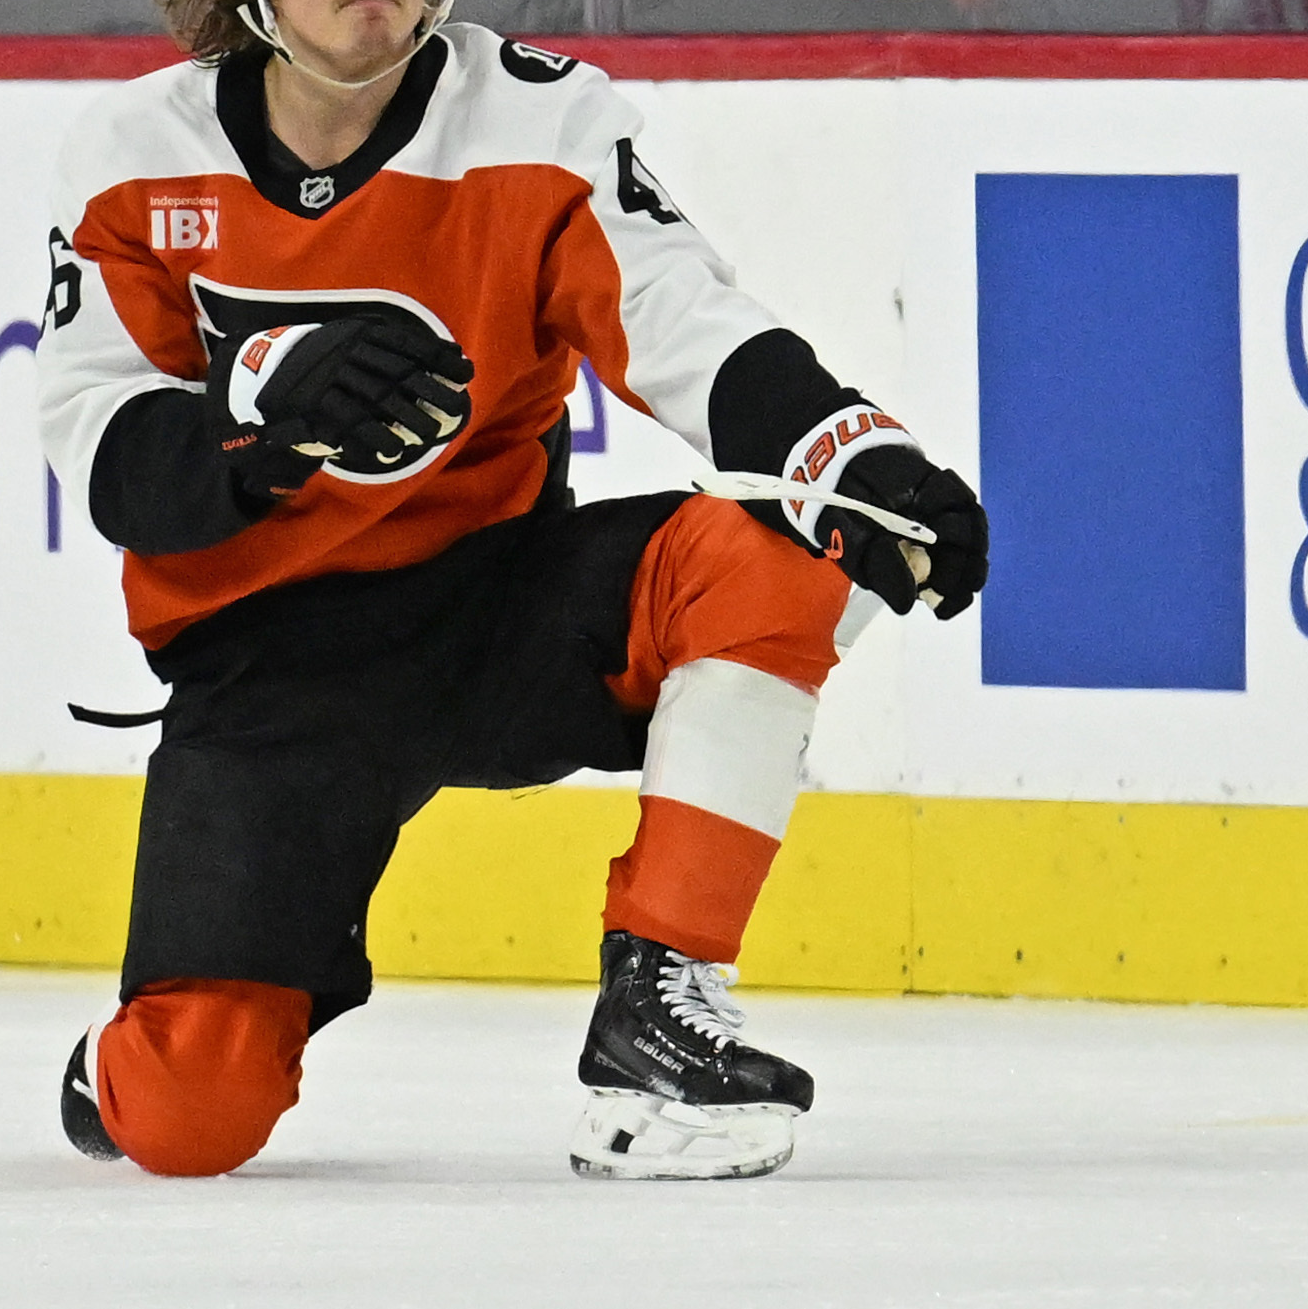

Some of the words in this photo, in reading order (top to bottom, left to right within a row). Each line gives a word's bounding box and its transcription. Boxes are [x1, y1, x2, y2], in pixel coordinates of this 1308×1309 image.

[615, 136, 695, 227] 4
[150, 208, 219, 250] IBX
[633, 1035, 686, 1075] BAUER
